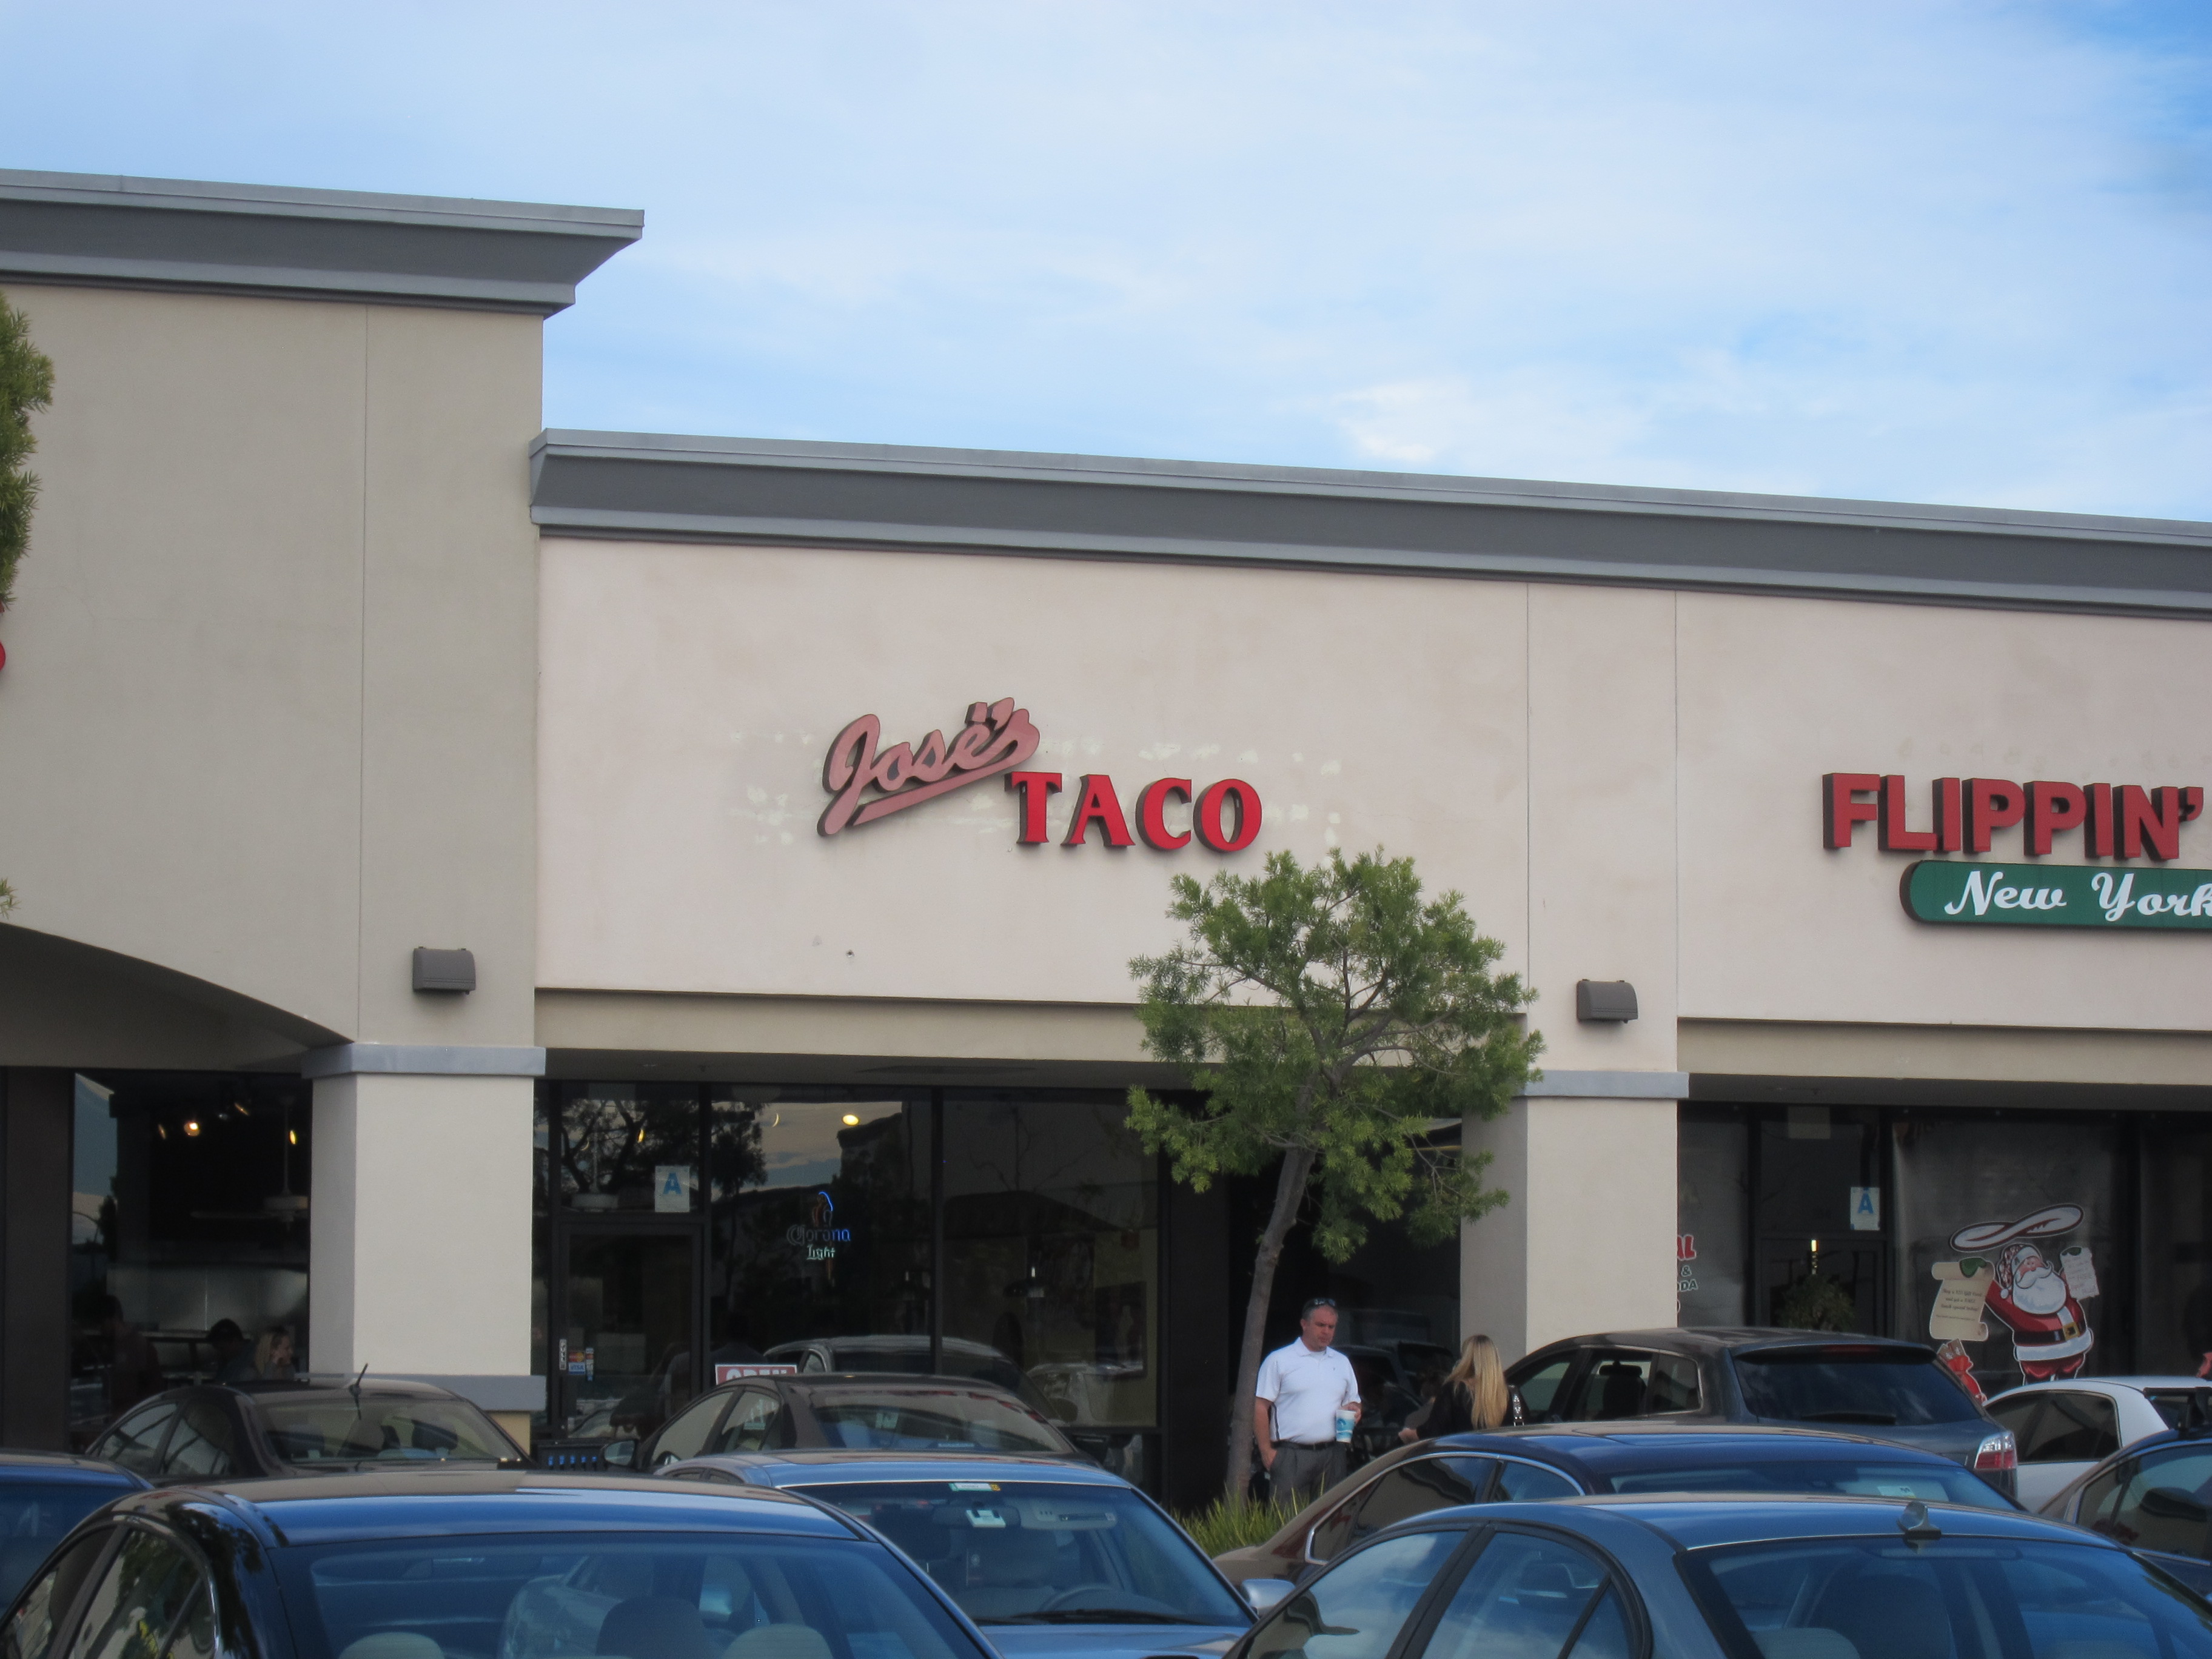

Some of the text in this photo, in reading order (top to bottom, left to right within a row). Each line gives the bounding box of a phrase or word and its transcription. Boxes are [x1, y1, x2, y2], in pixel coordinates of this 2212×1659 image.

[1004, 771, 1262, 853] TACO
[1822, 773, 2204, 860] FLIPPIN'
[1944, 870, 2067, 917] New
[663, 1172, 683, 1195] A
[1857, 1193, 1874, 1214] A
[786, 1224, 851, 1247] Corona
[806, 1243, 836, 1261] Light
[1681, 1265, 1692, 1277] &
